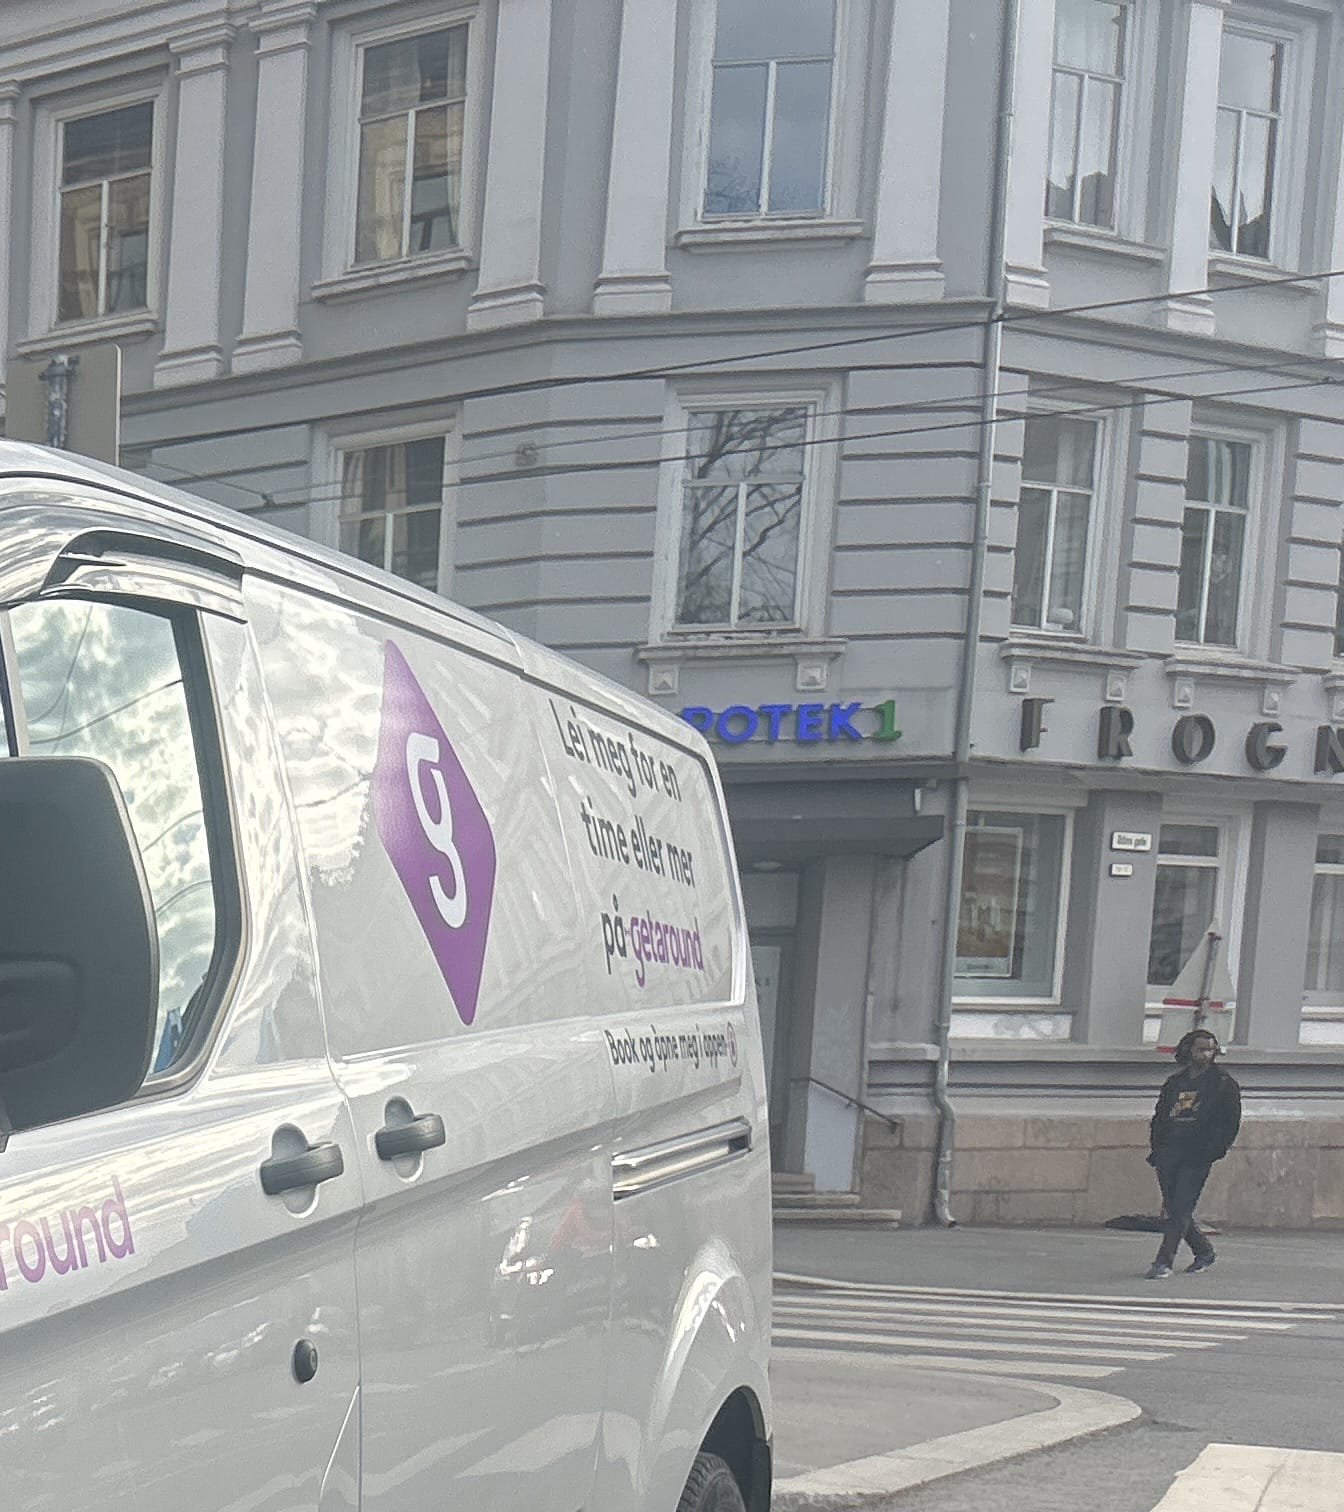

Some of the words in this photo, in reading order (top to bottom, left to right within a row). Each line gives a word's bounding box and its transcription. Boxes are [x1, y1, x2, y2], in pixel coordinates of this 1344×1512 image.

[549, 698, 591, 764] Lei
[589, 727, 637, 798] meg
[628, 732, 659, 792] for
[660, 760, 682, 803] en
[681, 702, 863, 743] POTEK
[873, 700, 902, 740] 1
[581, 796, 629, 865] time
[631, 815, 665, 877] eller
[666, 841, 695, 888] mer
[601, 894, 627, 975] på
[630, 910, 704, 988] getaround
[603, 1028, 640, 1065] Book
[640, 1037, 655, 1072] og
